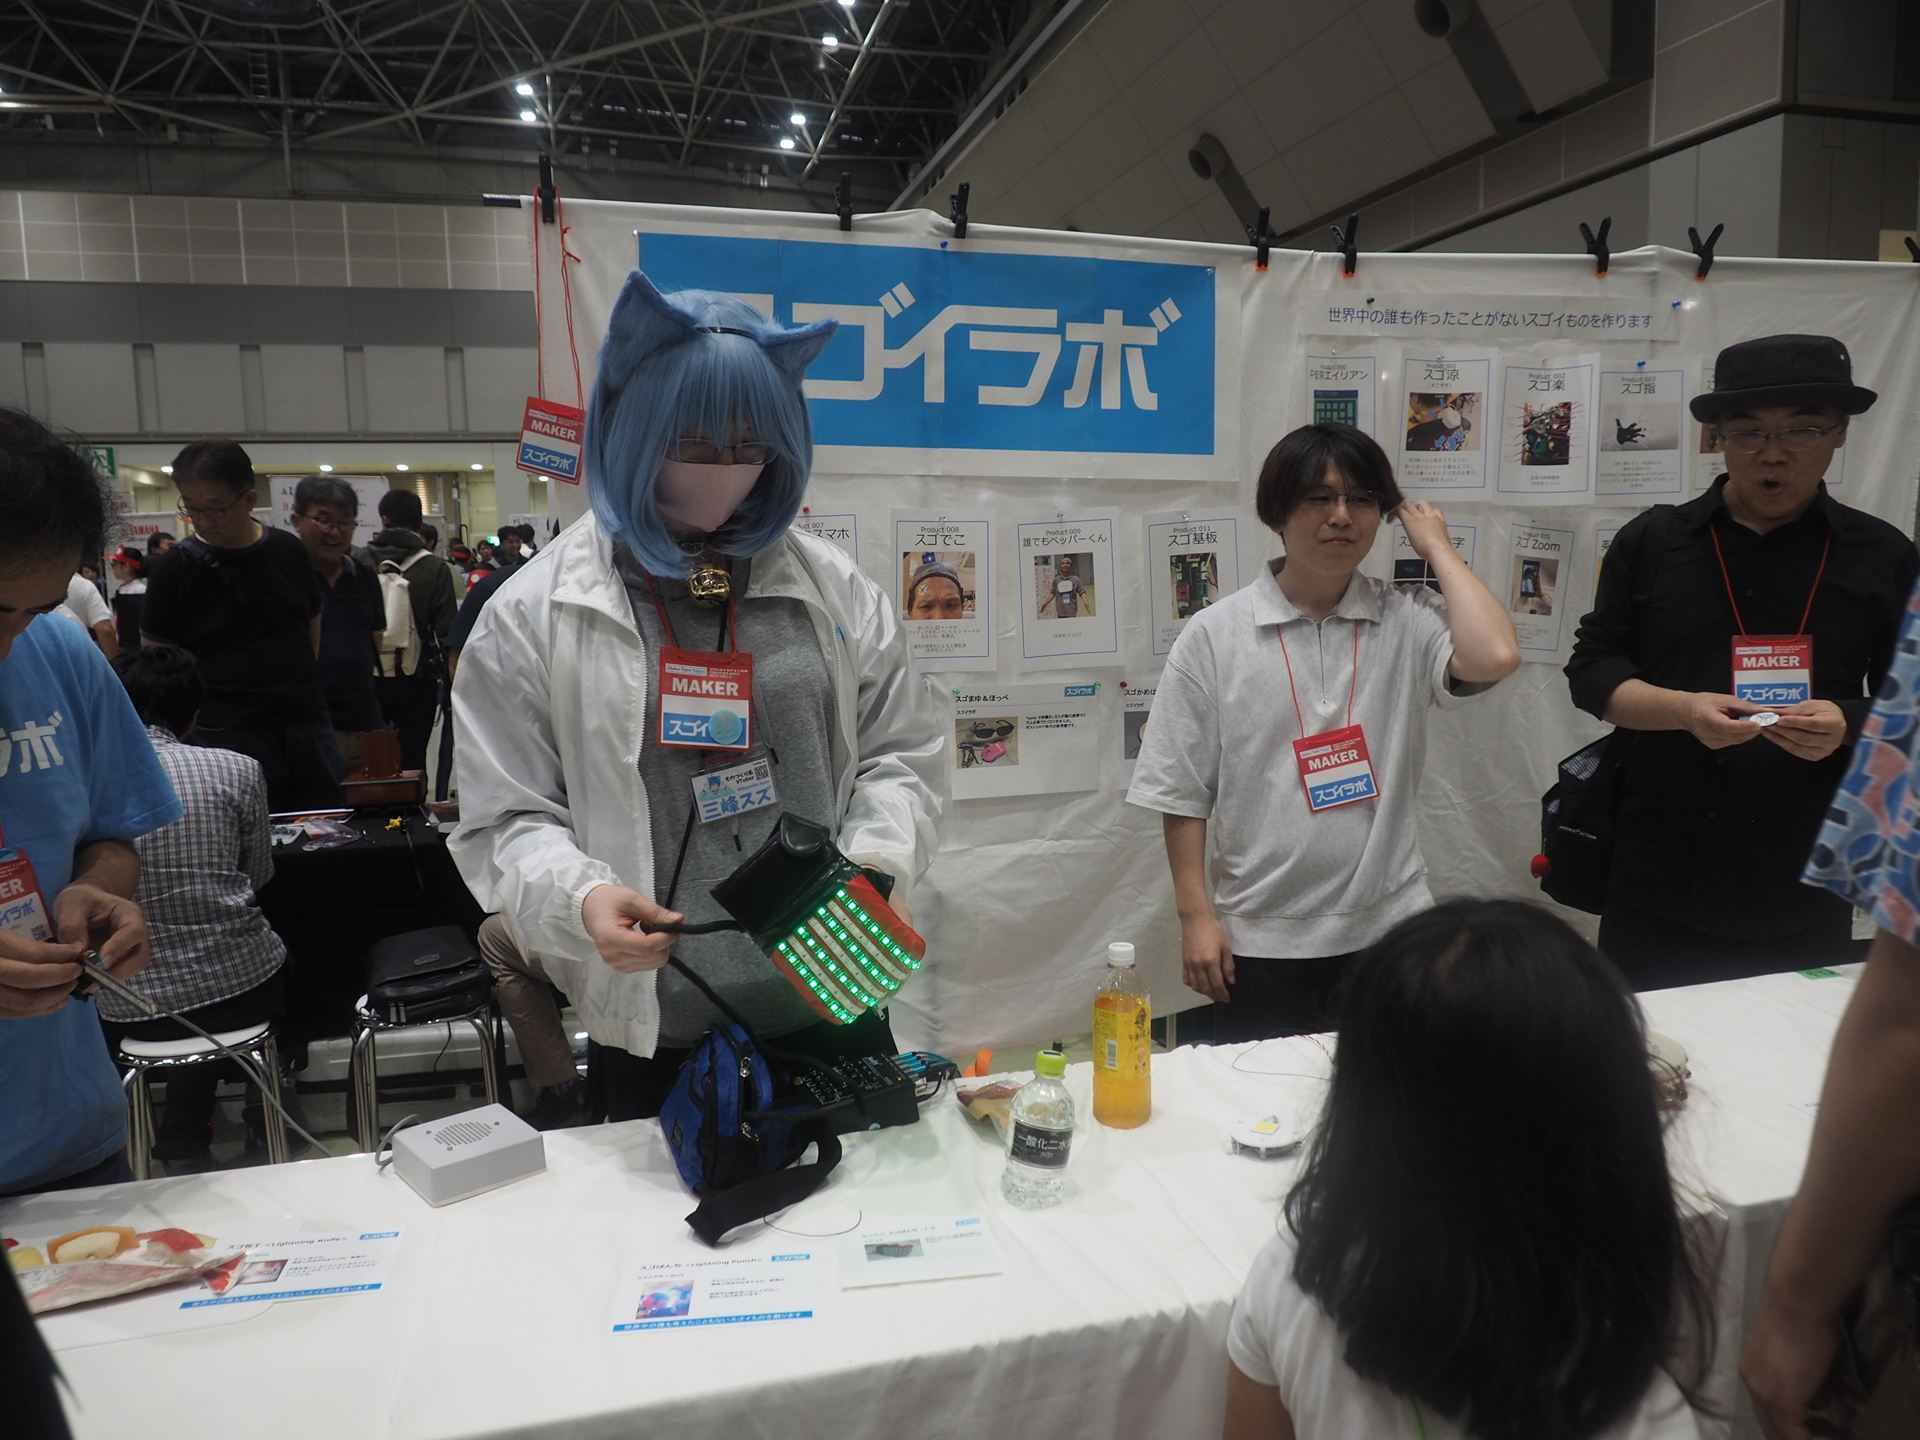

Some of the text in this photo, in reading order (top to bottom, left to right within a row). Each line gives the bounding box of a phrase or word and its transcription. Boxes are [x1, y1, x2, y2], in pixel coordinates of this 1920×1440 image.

[1329, 307, 1653, 329] 世界中の誰も作ったことがないスゴイものを作ります
[727, 281, 1183, 411] ゴイラボ
[1528, 379, 1566, 391] スゴ楽
[1621, 383, 1656, 394] スゴ指
[531, 420, 576, 440] MAKER
[524, 448, 573, 471] スゴイラボ
[915, 534, 966, 546] スゴでこ
[1023, 535, 1107, 547] 誰でもペッパーくん
[1168, 532, 1218, 547] スゴ基板
[1532, 539, 1561, 552] Zoom
[1743, 656, 1800, 668] MAKER
[672, 678, 739, 697] MAKER
[1742, 687, 1804, 701] スゴイラボ
[669, 720, 710, 738] スゴイ
[1308, 749, 1359, 770] MAKER
[1315, 778, 1368, 803] スゴイラボ
